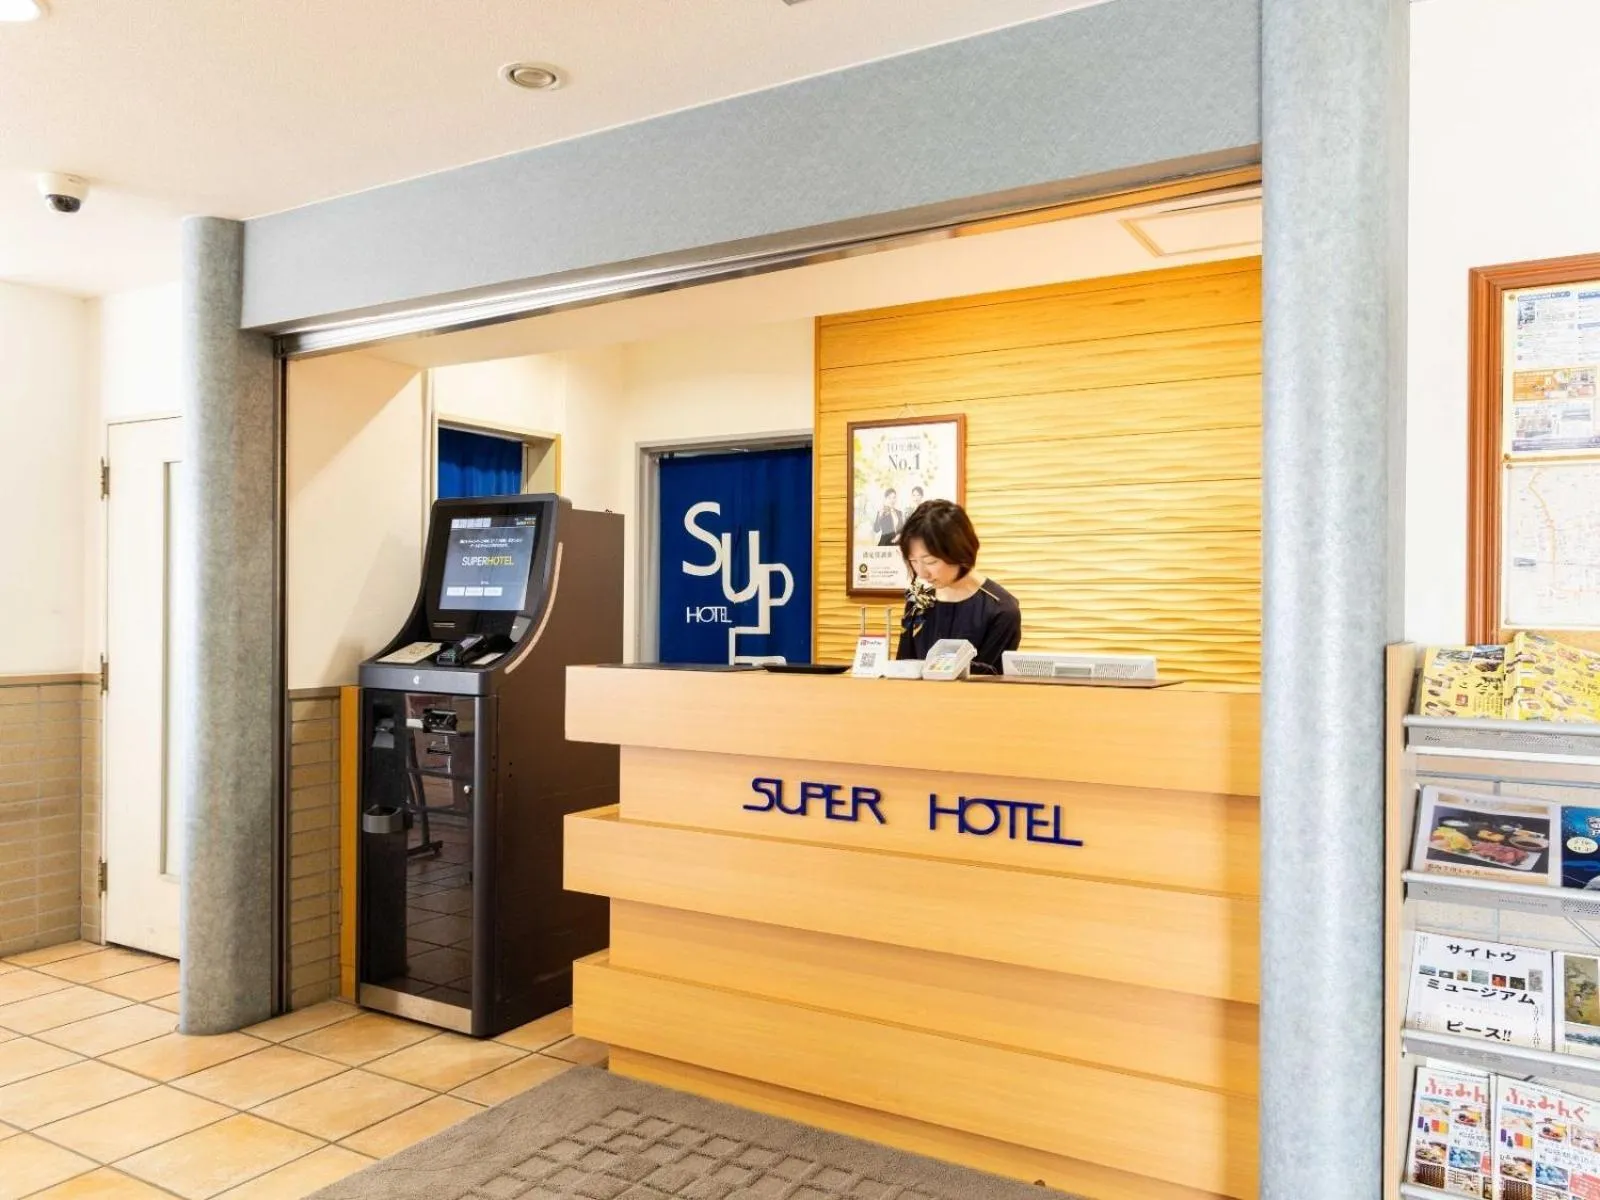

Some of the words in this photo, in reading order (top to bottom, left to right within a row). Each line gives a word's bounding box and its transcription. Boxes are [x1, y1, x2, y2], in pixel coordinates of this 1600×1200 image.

[888, 453, 920, 471] No.1
[682, 501, 794, 665] SUPE
[686, 606, 732, 623] HOTEL
[743, 777, 886, 824] SUPER
[929, 794, 1083, 847] HOTEL
[1446, 944, 1516, 961] サイトウ
[1427, 979, 1535, 1005] ミュージアム
